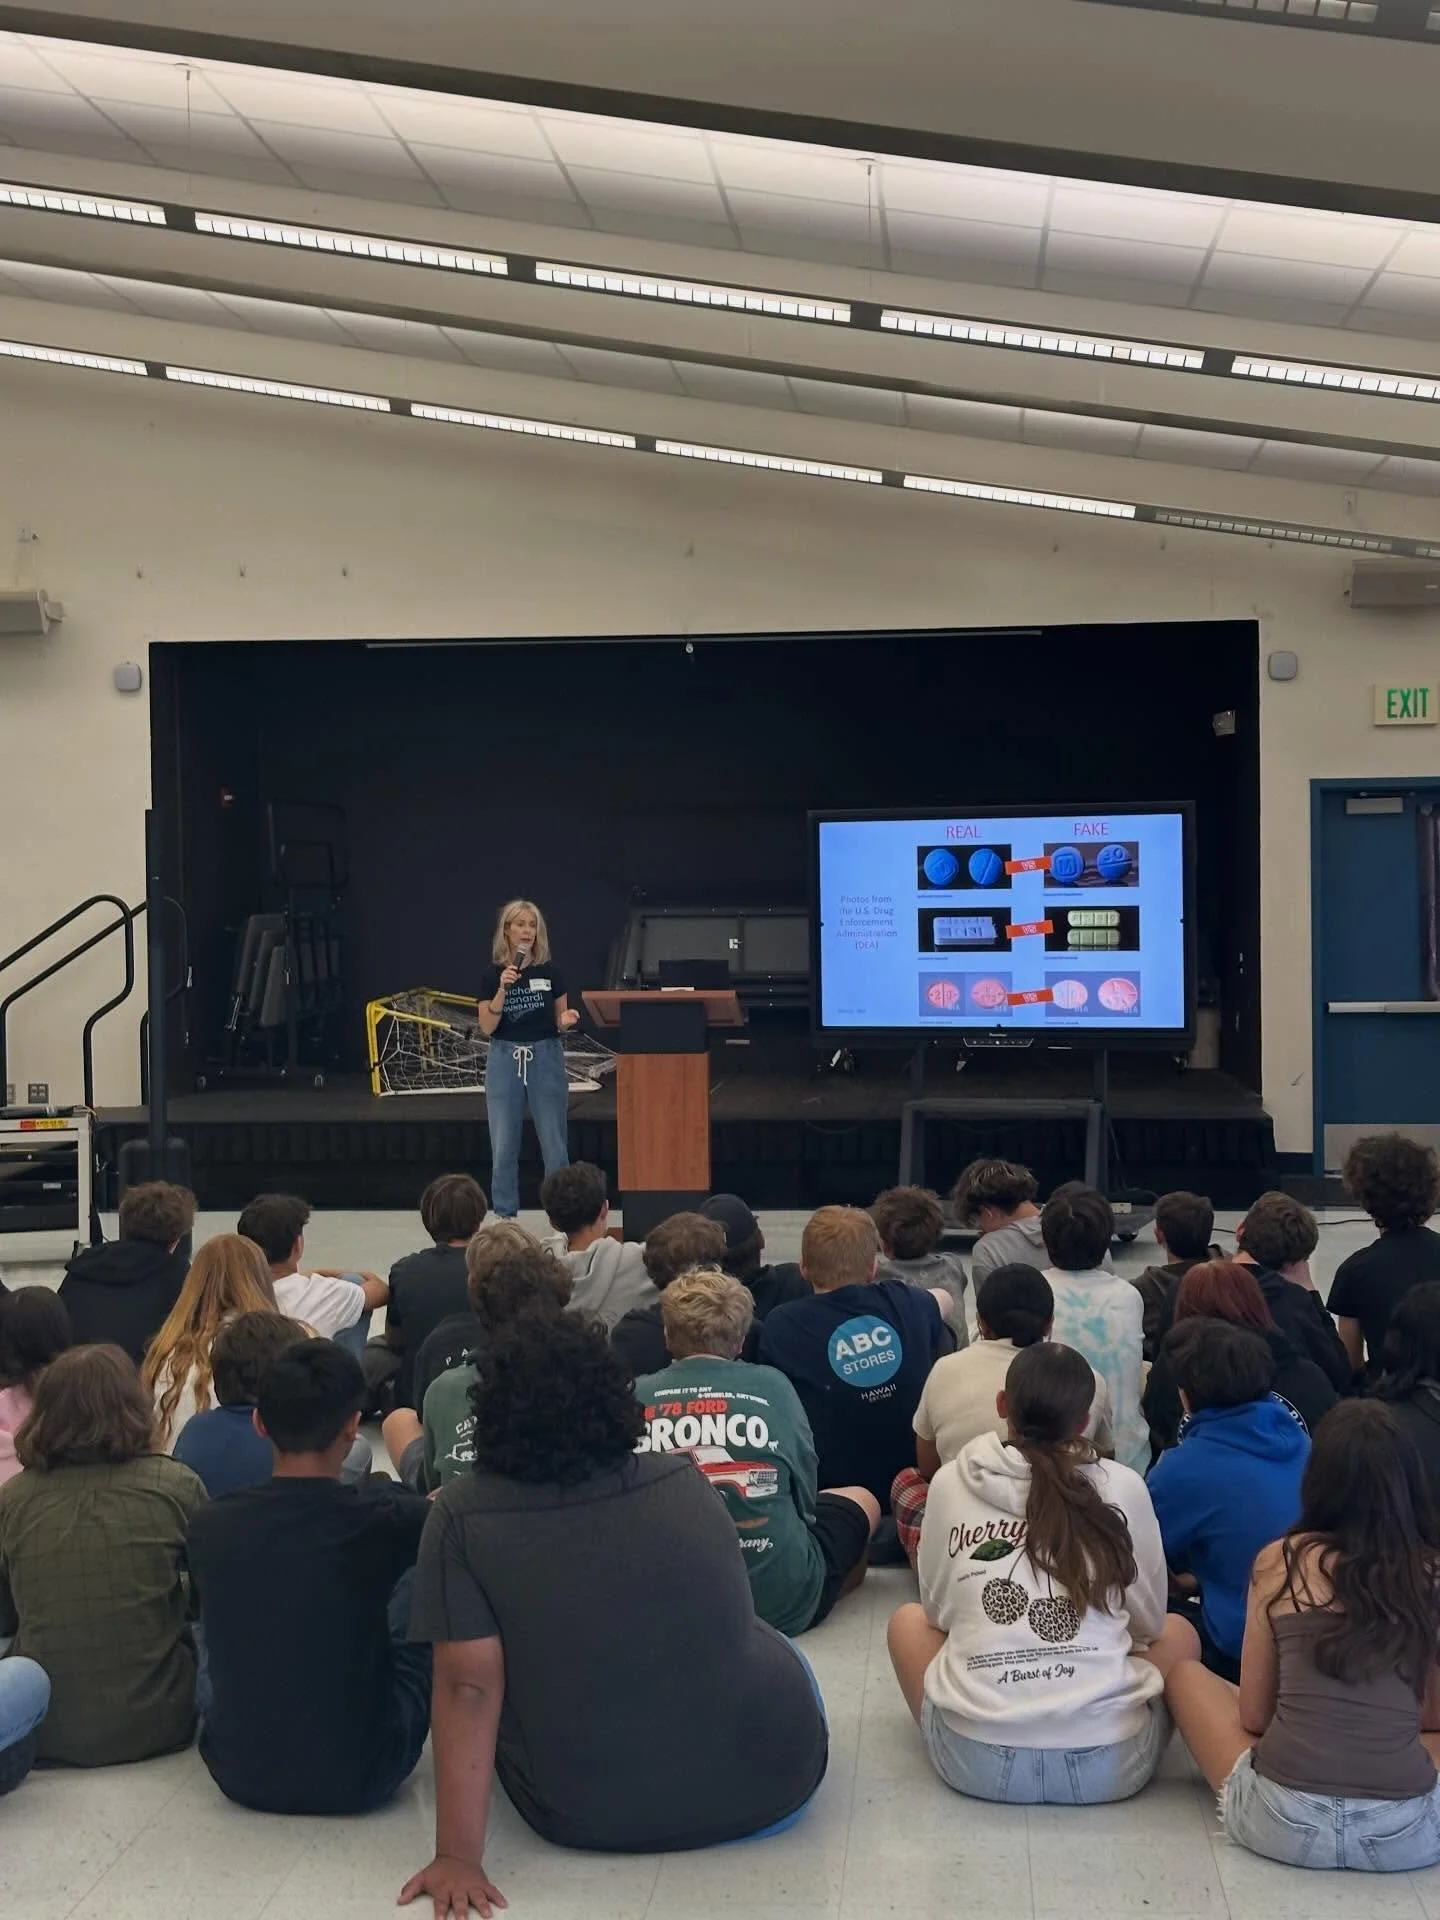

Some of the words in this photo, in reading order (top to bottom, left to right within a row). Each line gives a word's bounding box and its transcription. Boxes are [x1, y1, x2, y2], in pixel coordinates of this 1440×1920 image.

[1387, 688, 1429, 718] EXIT
[946, 825, 982, 839] REAL
[1074, 822, 1109, 836] FAKE
[840, 895, 869, 903] Photos
[871, 895, 892, 903] from
[840, 907, 853, 915] the
[856, 907, 870, 915] U.S.
[874, 907, 894, 917] Drug
[840, 918, 893, 927] Enforcement
[837, 930, 898, 938] Administration
[855, 941, 879, 950] (DEA)
[504, 992, 544, 1005] eonardi
[504, 1001, 544, 1011] OUNDATION
[836, 1326, 892, 1360] ABC
[843, 1350, 896, 1375] STORES
[861, 1383, 897, 1400] HAWAII
[660, 1402, 682, 1417] '78
[686, 1400, 728, 1414] FORD
[949, 1519, 1028, 1558] Cherry
[996, 1670, 1009, 1684] A
[1011, 1667, 1040, 1682] Burst
[1042, 1665, 1052, 1680] of
[1055, 1663, 1075, 1678] Joy
